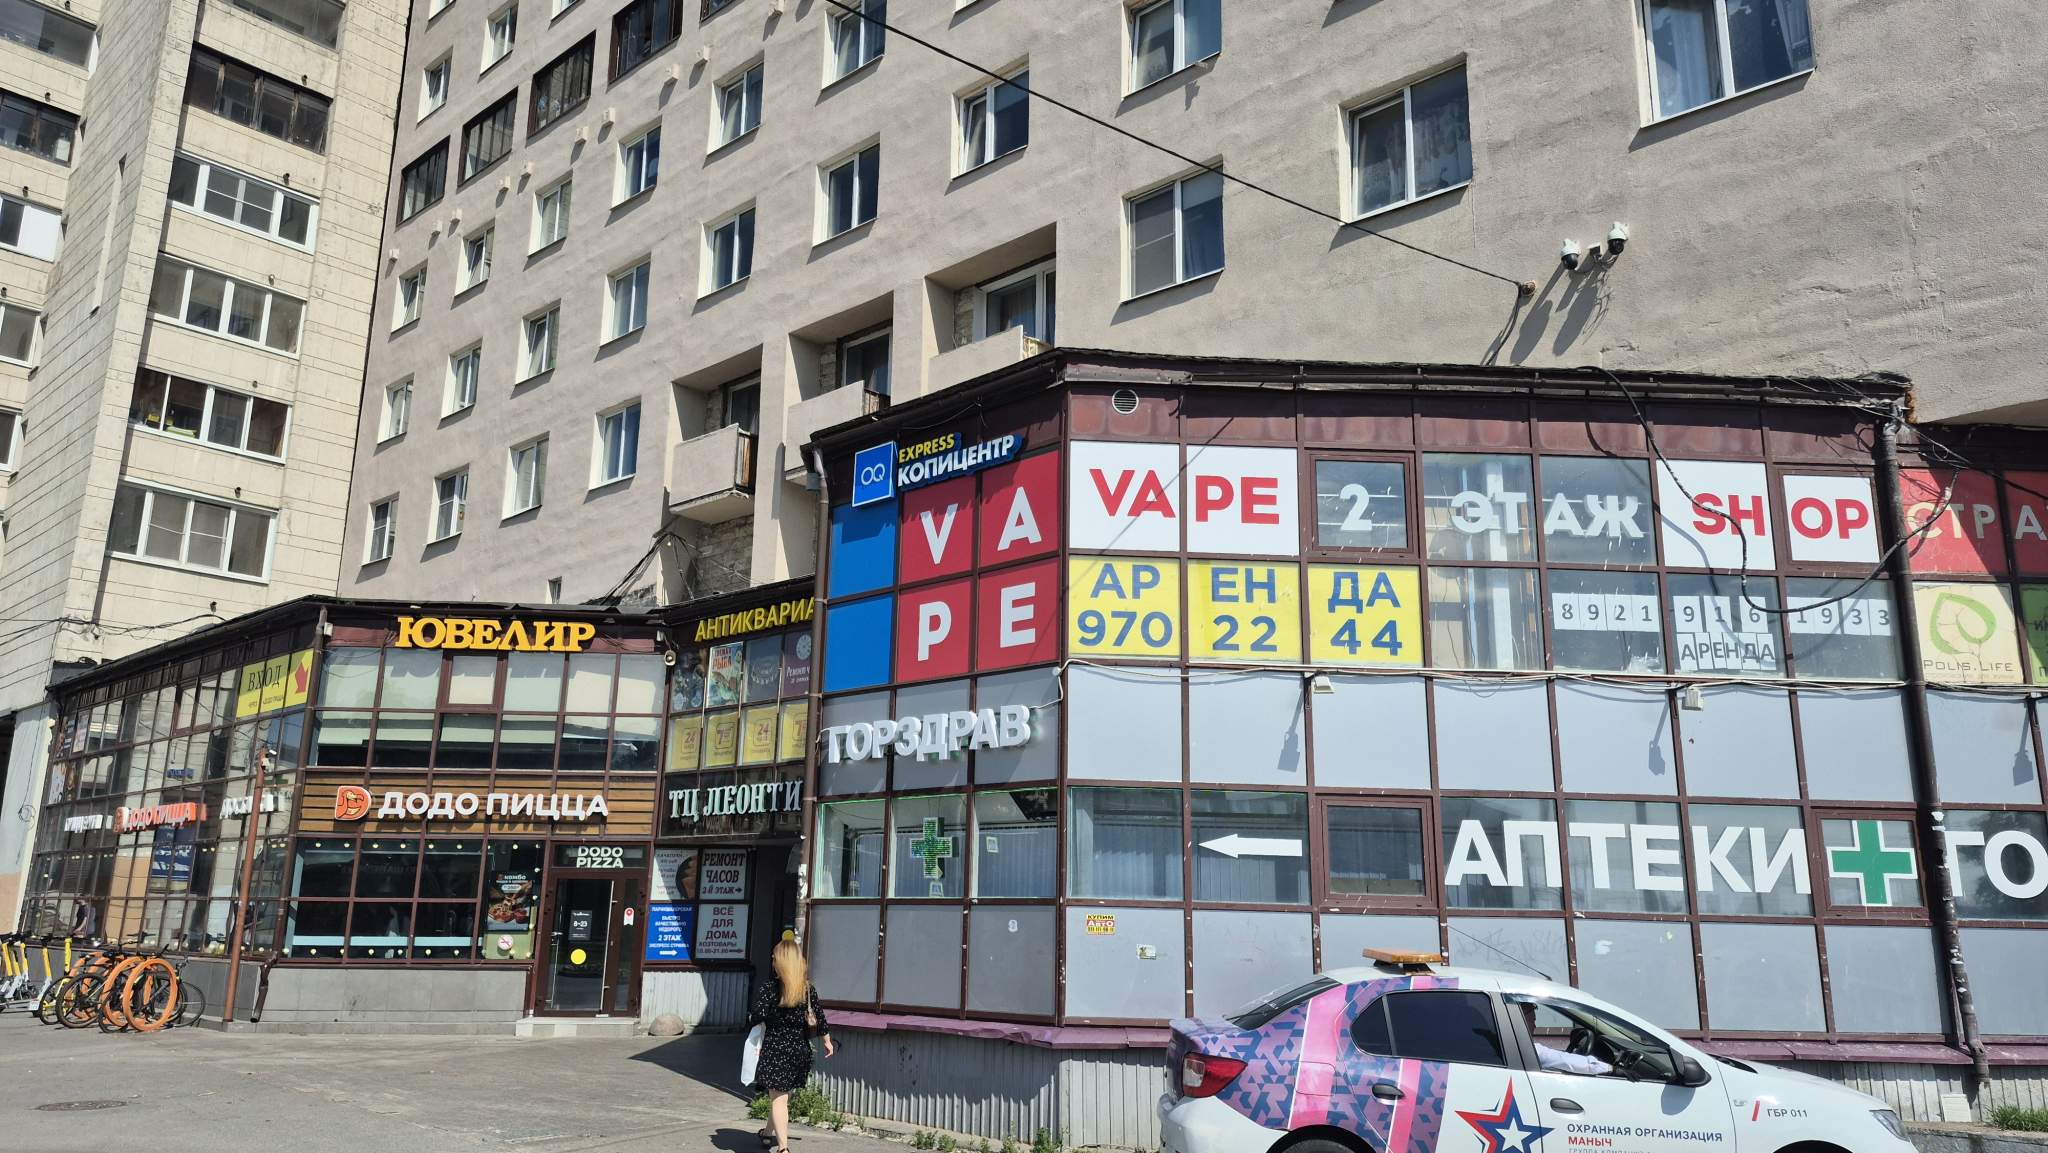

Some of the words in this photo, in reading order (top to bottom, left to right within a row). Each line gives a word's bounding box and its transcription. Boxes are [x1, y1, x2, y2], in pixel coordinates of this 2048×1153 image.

[899, 433, 956, 463] EXPRESS
[897, 434, 1015, 487] КОПИЦЕНТР
[1339, 483, 1373, 531] 2
[1450, 490, 1645, 538] ЭТАЖ
[1907, 501, 2048, 541] СТРА
[1561, 603, 1653, 622] 8921
[395, 615, 596, 652] ЮВЕЛИР
[1077, 610, 1173, 648] 970
[1680, 641, 1775, 663] АРЕНДА
[247, 665, 283, 692] ВХОД
[827, 704, 1032, 764] ГОРЗДРАВ
[378, 792, 480, 820] ДОДО
[486, 793, 609, 821] ПИЦЦА
[668, 788, 700, 822] ТЦ
[577, 846, 624, 858] DODO
[703, 853, 746, 867] РЕМОНТ
[1444, 818, 1812, 895] АПТЕКИ
[576, 857, 625, 869] PIZZA
[706, 869, 740, 883] ЧАСОВ
[715, 886, 735, 895] ЭТАЖ
[713, 906, 735, 916] ВСЁ
[710, 918, 734, 929] ДЛЯ
[705, 930, 738, 941] ДОМА
[1767, 1108, 1788, 1117] ГБР
[1790, 1108, 1808, 1118] 011
[1567, 1123, 1631, 1136] ОХРАННАЯ
[1634, 1127, 1723, 1142] ОРГАНИЗАЦИЯ
[1568, 1136, 1613, 1147] МАНЫЧ
